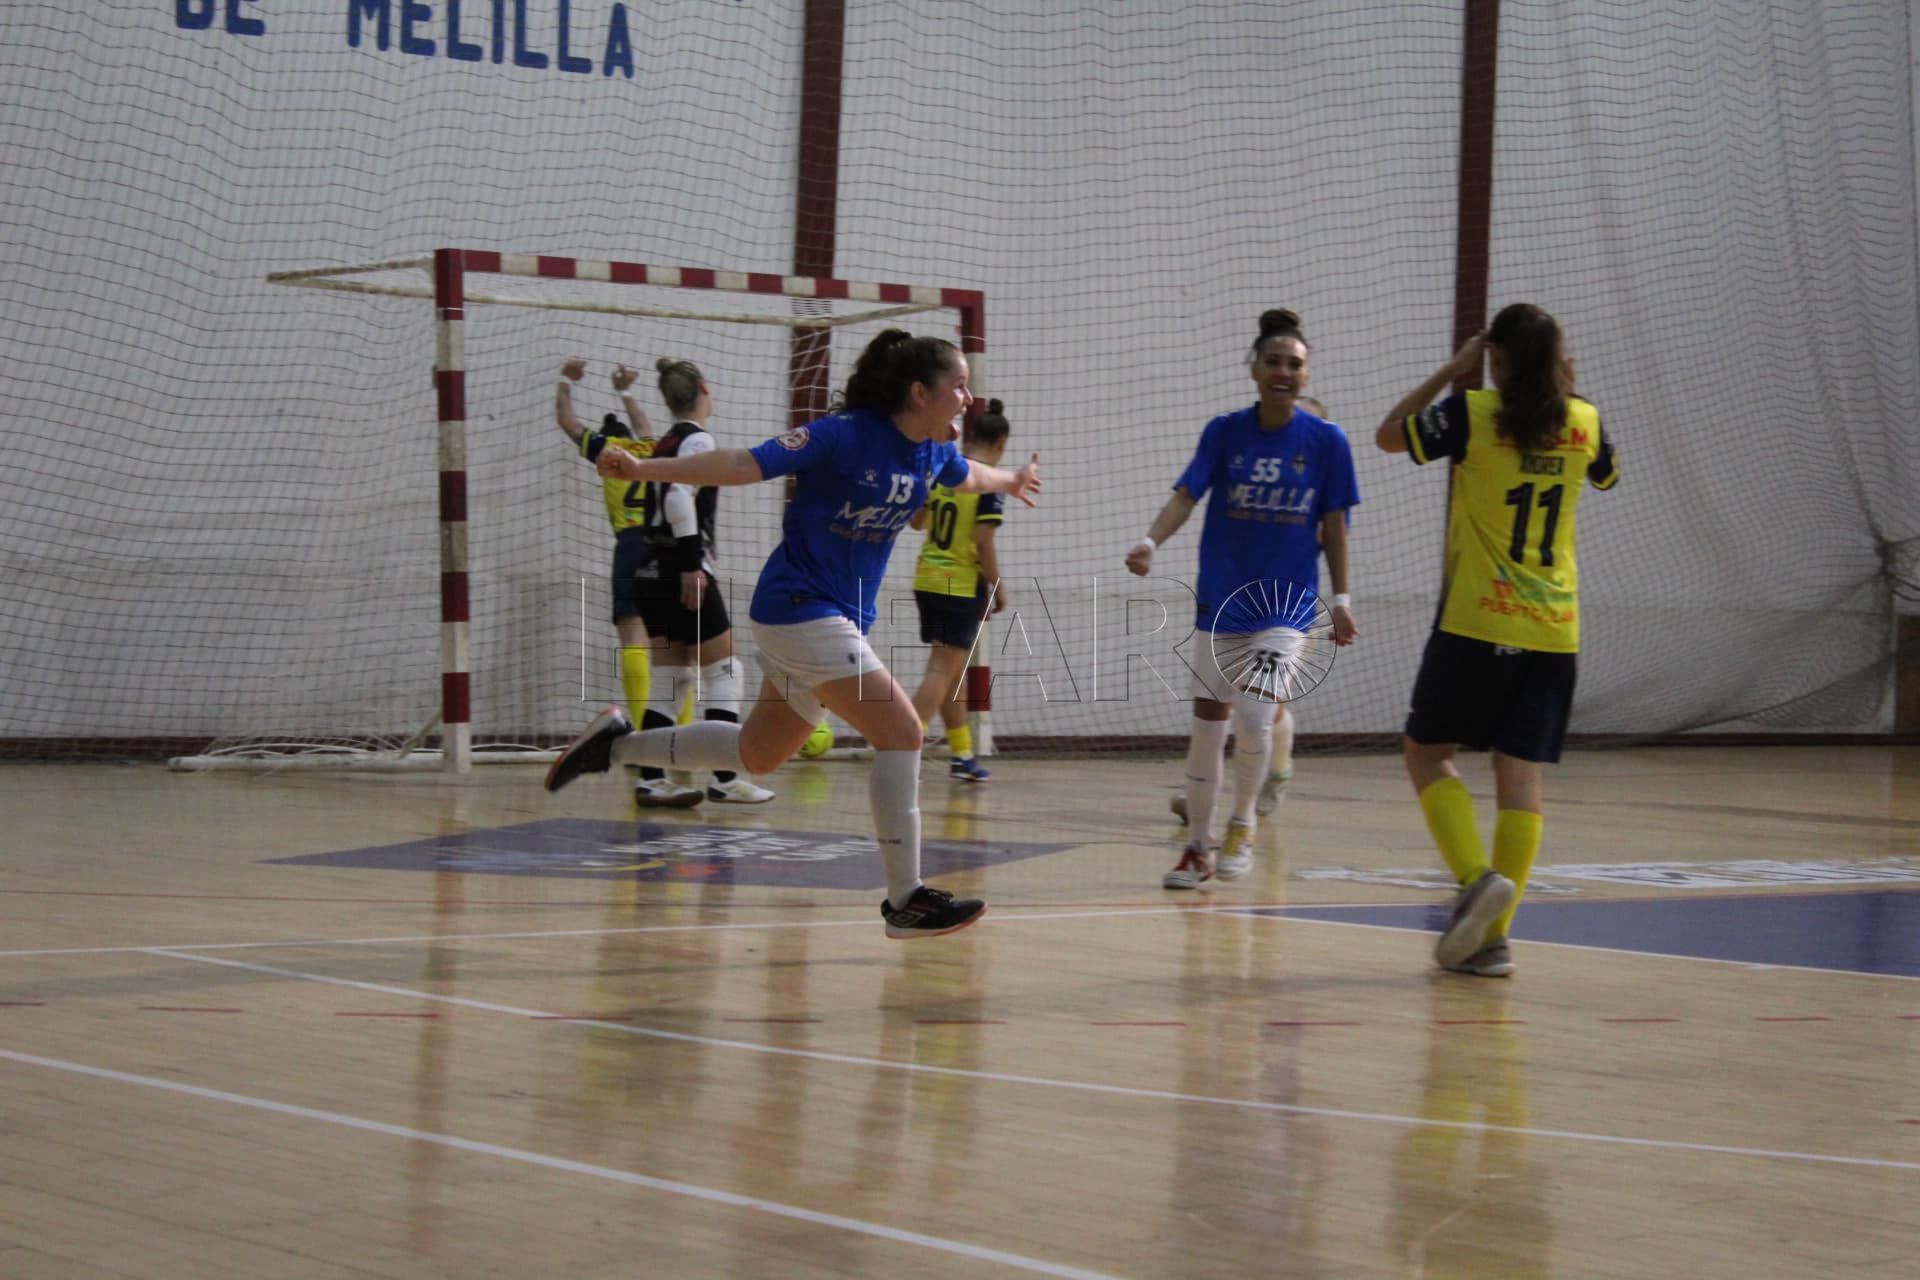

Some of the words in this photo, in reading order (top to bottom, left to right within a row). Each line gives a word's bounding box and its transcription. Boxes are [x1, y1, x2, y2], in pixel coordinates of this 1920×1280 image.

[346, 0, 634, 79] MELILLA
[885, 473, 915, 505] 13
[1249, 457, 1283, 483] 55
[929, 498, 958, 551] 10
[1505, 482, 1564, 568] 11
